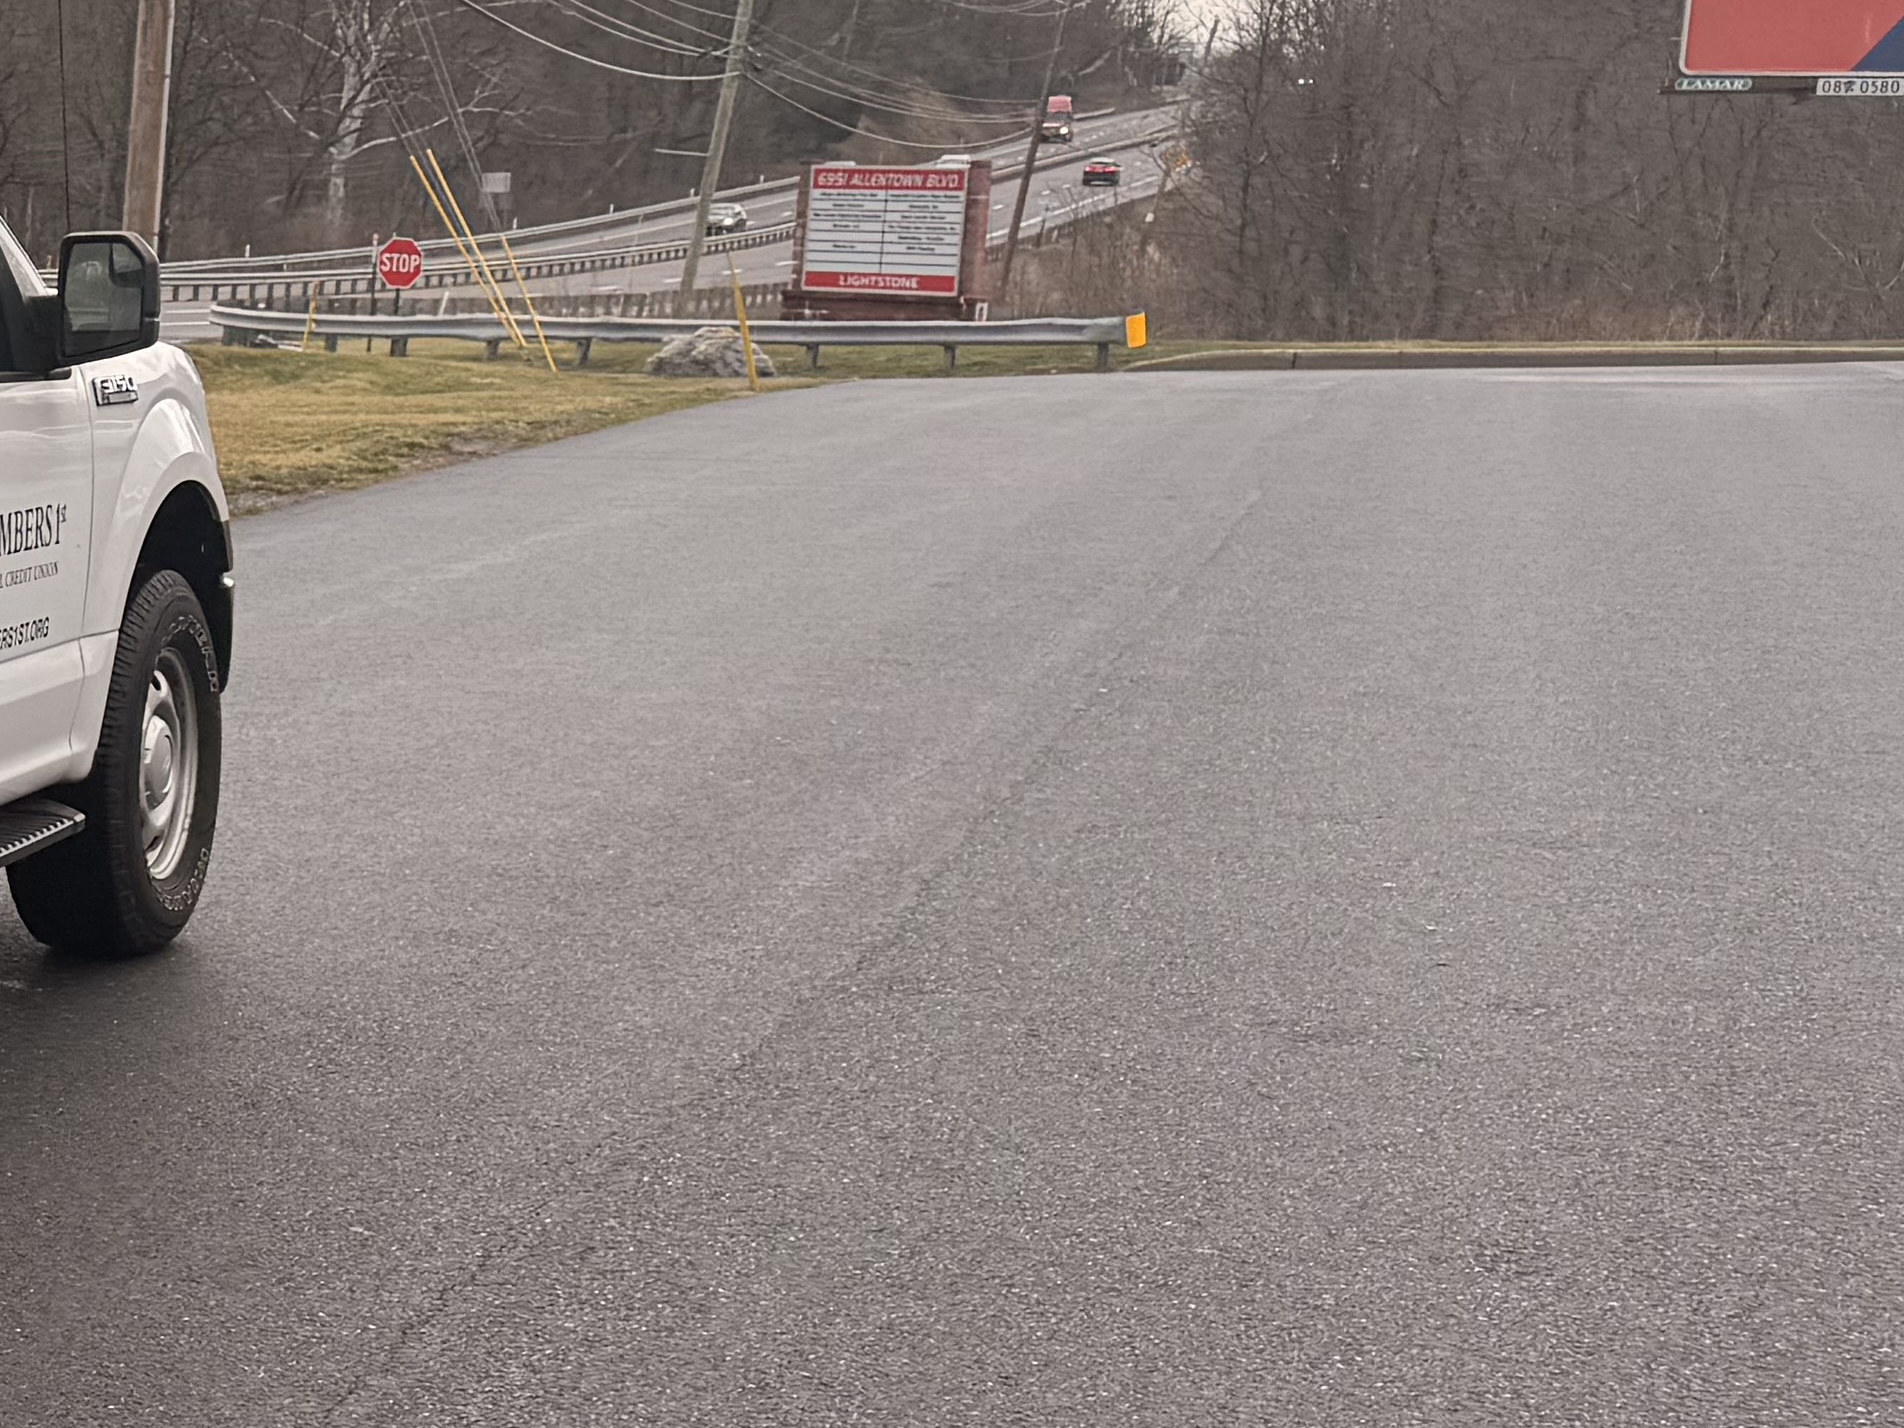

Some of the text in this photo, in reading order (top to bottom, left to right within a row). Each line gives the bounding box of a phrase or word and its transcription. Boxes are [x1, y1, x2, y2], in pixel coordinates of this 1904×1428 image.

[1680, 79, 1745, 90] LAMAR
[850, 173, 923, 188] ALLENTOWN
[380, 253, 420, 272] STOP
[839, 275, 920, 289] LIGHTSTONE
[5, 567, 33, 588] CREDIT
